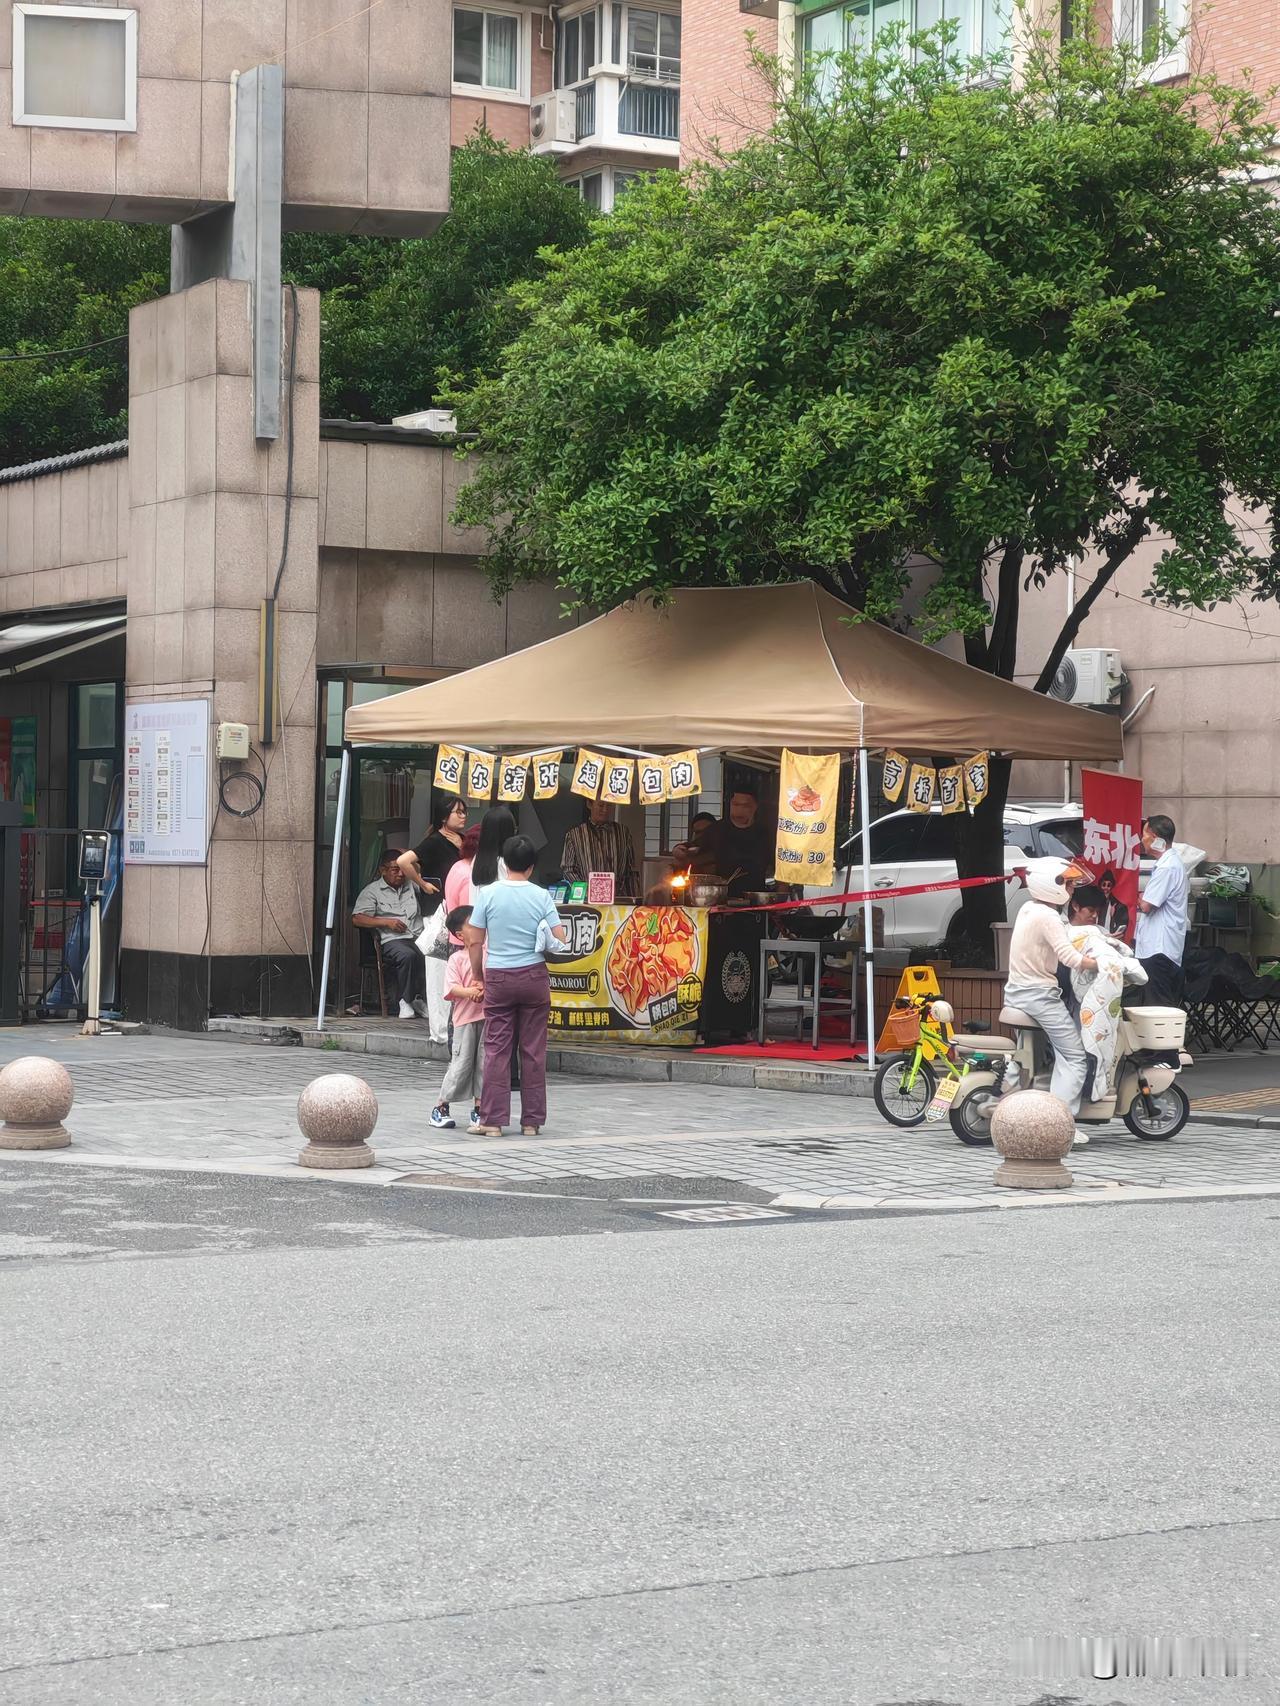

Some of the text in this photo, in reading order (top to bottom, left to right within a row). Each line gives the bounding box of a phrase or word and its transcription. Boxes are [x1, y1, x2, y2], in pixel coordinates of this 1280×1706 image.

[810, 820, 828, 835] 20
[1083, 817, 1141, 871] 东北
[807, 850, 826, 864] 30
[651, 998, 677, 1022] 锅包肉
[654, 1020, 669, 1034] SHAO
